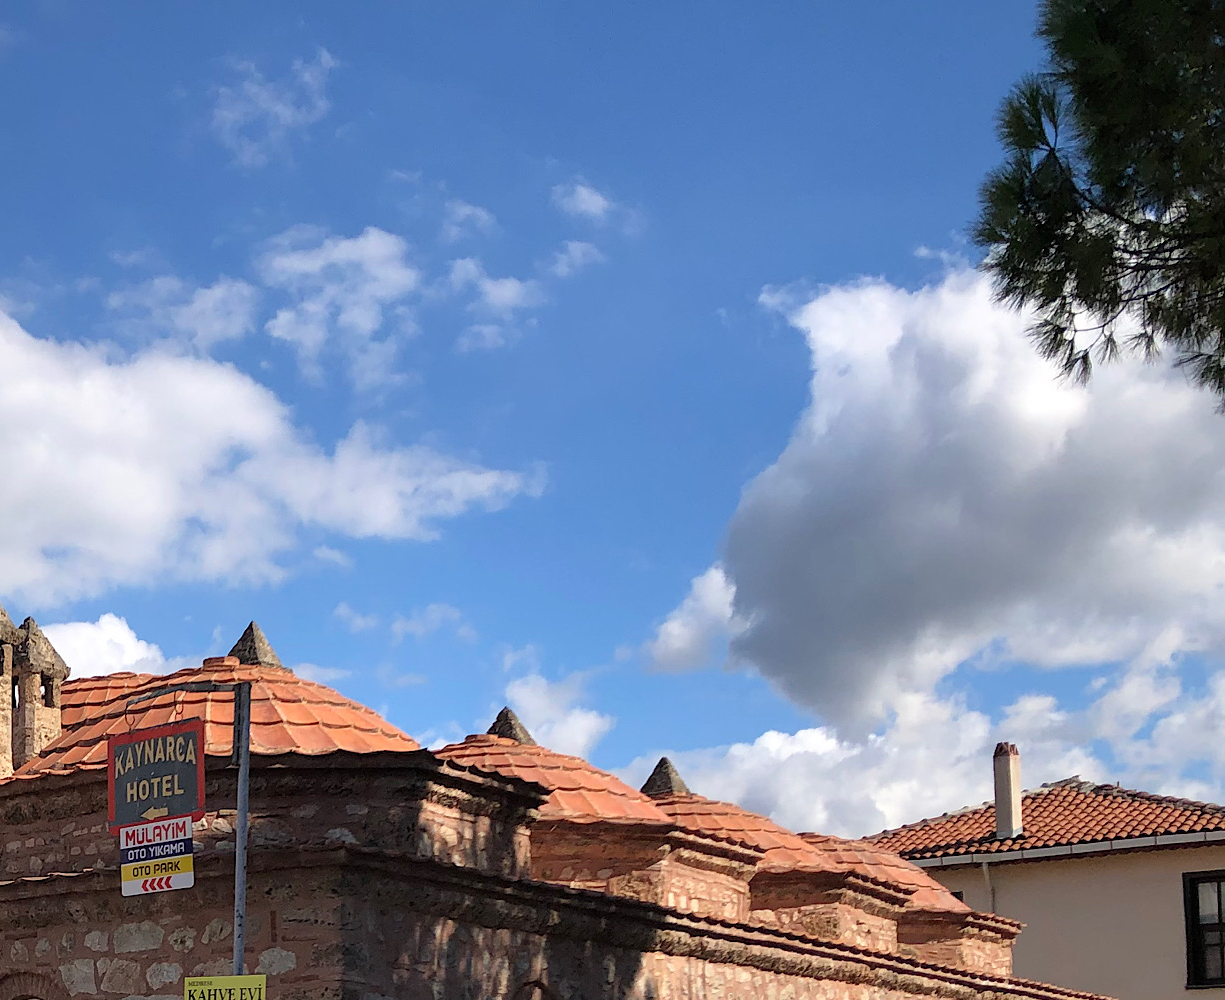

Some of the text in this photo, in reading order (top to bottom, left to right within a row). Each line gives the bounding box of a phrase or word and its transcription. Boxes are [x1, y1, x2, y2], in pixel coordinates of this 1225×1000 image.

[115, 736, 196, 779] KAYNARCA
[127, 775, 184, 802] HOTEL
[128, 842, 185, 861] OTO YIKAMA
[132, 860, 181, 877] OTO PARK
